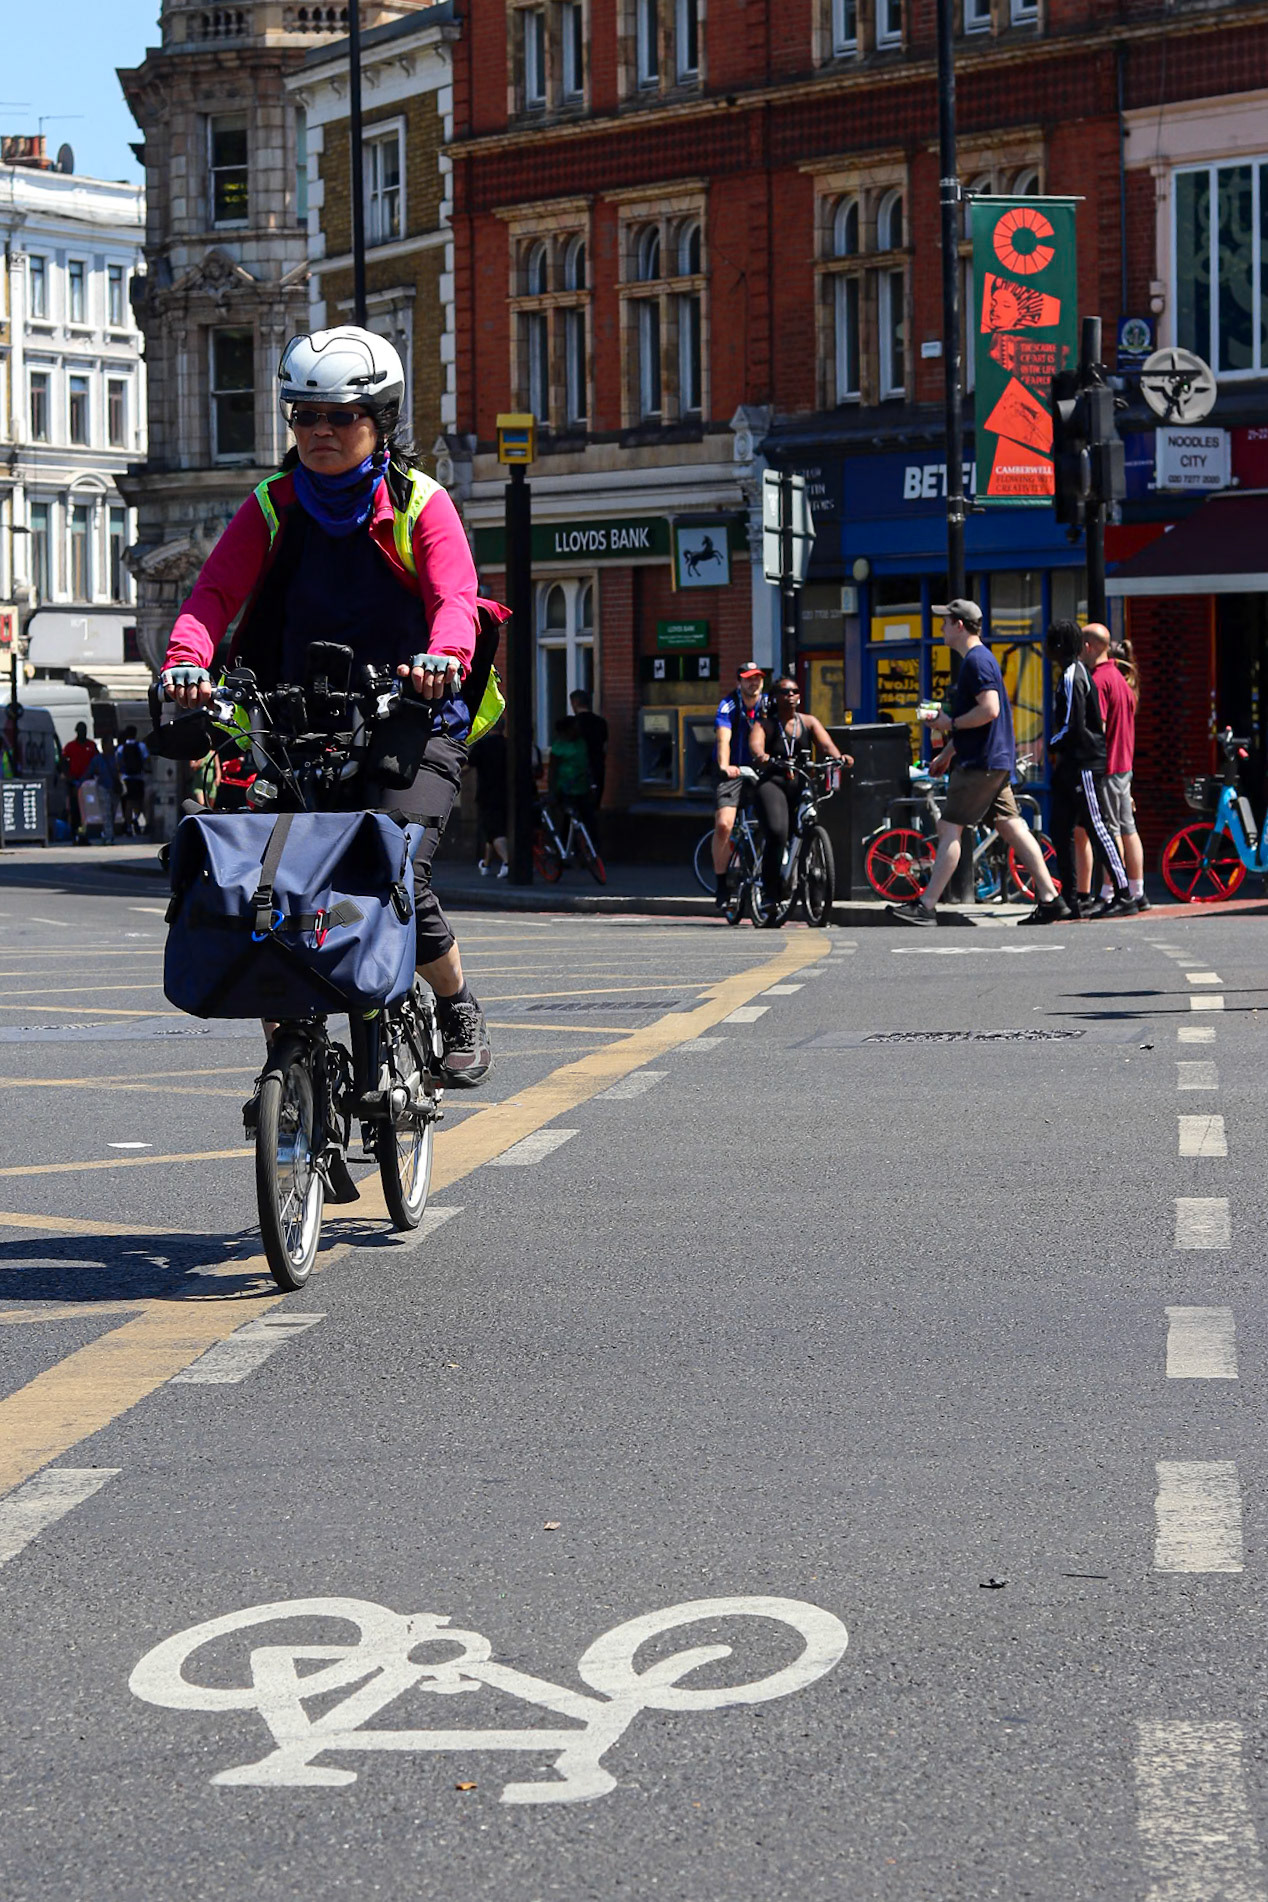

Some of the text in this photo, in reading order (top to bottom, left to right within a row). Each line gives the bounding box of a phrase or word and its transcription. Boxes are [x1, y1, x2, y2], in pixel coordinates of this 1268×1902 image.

[1168, 436, 1219, 448] NOODLES
[1180, 455, 1207, 468] CITY
[995, 465, 1053, 475] CAMBERWELL
[555, 527, 650, 552] LLOYDS BANK
